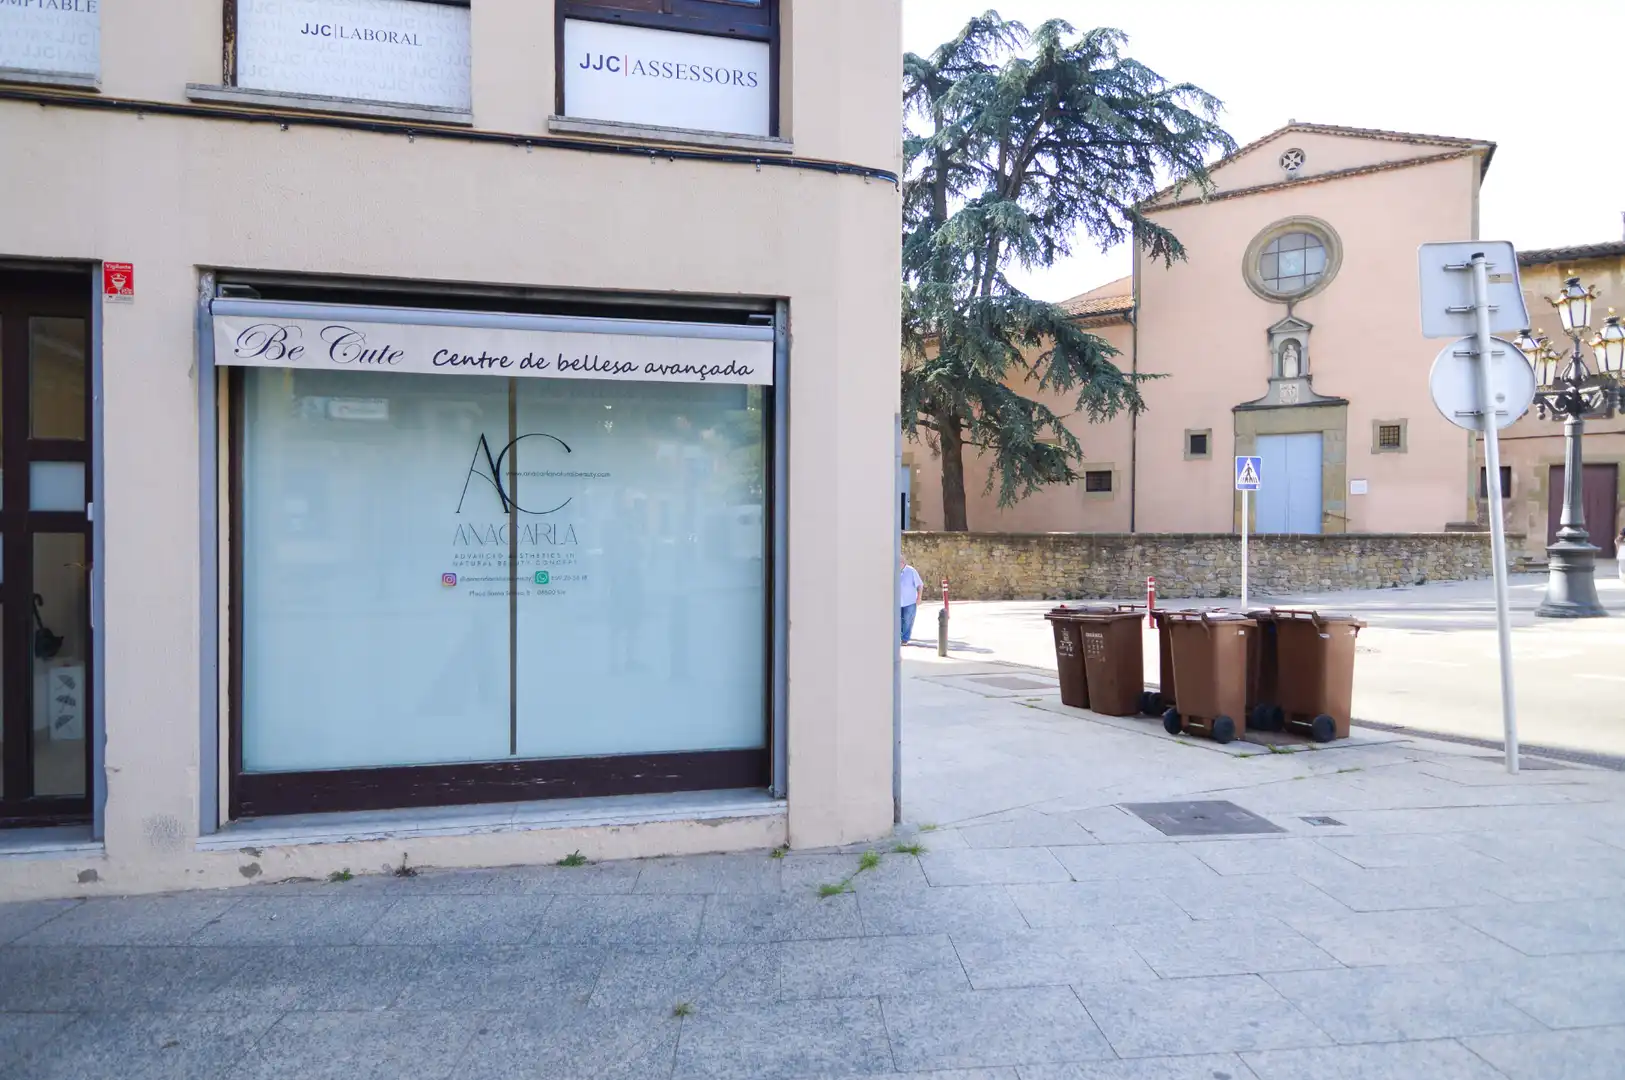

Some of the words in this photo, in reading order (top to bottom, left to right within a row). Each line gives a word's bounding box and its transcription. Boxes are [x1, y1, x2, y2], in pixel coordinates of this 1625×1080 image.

[340, 26, 423, 47] LABORAL
[631, 59, 759, 88] ASSESSORS
[234, 323, 305, 361] Be
[320, 325, 404, 364] Cute
[432, 349, 514, 368] Centre
[519, 352, 551, 370] de
[557, 354, 639, 375] bellesa
[644, 359, 754, 381] avançada
[452, 523, 578, 546] ANACARLA
